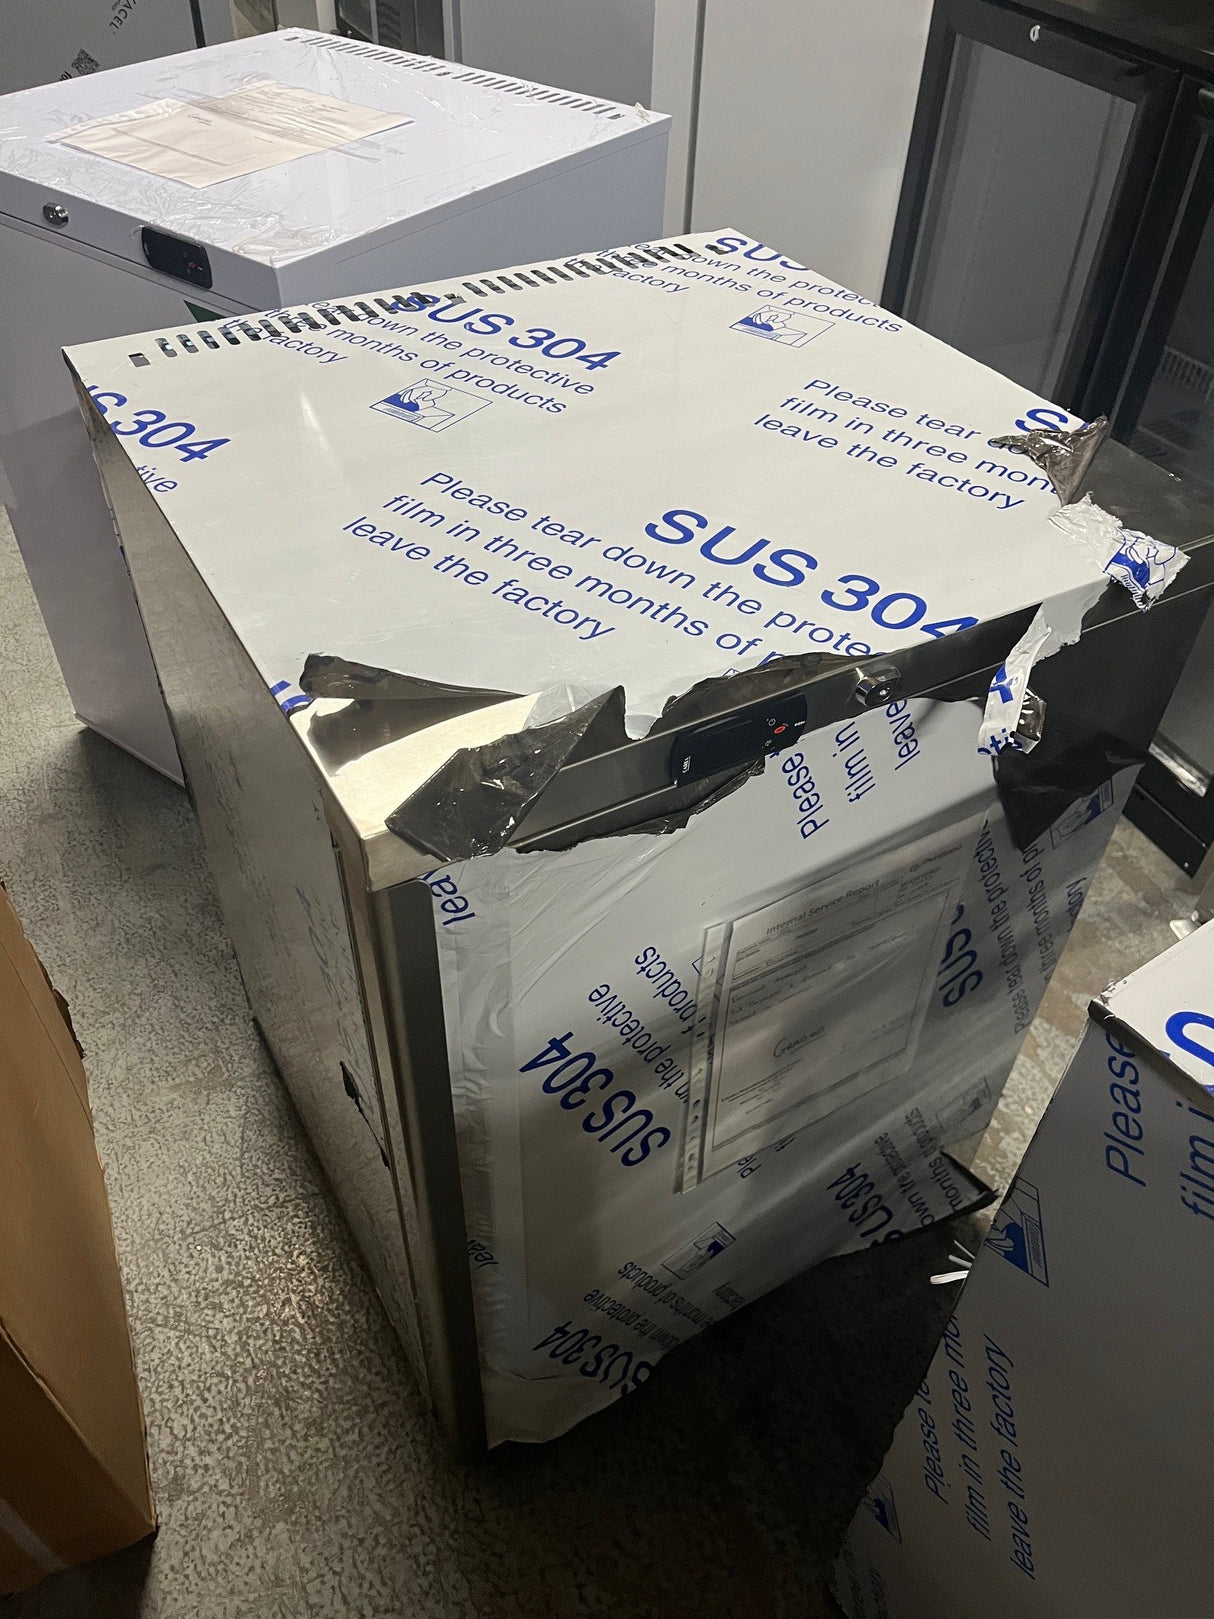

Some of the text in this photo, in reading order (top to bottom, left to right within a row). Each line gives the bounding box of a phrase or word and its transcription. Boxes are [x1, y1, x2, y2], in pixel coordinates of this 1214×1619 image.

[606, 268, 690, 294] actory
[660, 264, 752, 293] months
[756, 288, 787, 300] of
[783, 297, 904, 334] products
[746, 266, 787, 284] the
[391, 294, 621, 371] SUS 304
[420, 330, 463, 351] the
[459, 346, 595, 395] protective
[326, 328, 419, 363] months
[419, 357, 457, 372] of
[447, 367, 568, 414] products
[110, 410, 232, 463] 304
[779, 396, 839, 423] film
[844, 415, 875, 435] in
[881, 428, 970, 465] three
[802, 379, 982, 441] Please tear
[753, 413, 1026, 511] leave the factory
[342, 515, 617, 641] leave the factory
[382, 494, 763, 657] film in three months of
[419, 471, 529, 522] Please
[530, 514, 603, 550] tear
[602, 544, 698, 590] down
[701, 580, 763, 615] the
[644, 508, 980, 641] SUS 304
[833, 721, 876, 803] film in
[886, 700, 921, 771] leave
[781, 752, 830, 840] Please
[1019, 861, 1043, 884] of
[1026, 879, 1051, 936] months
[766, 910, 807, 936] Internal
[988, 900, 1008, 931] the
[998, 930, 1019, 968] down
[634, 946, 698, 1023] products
[587, 983, 685, 1090] the protective
[518, 1030, 671, 1167] SUS 304
[1103, 1032, 1148, 1188] Please
[826, 1162, 876, 1211] 304
[583, 1288, 640, 1329] protective
[617, 1261, 671, 1304] products
[531, 1320, 603, 1366] 304
[947, 1369, 979, 1453] three
[917, 1406, 950, 1506] Please
[958, 1453, 984, 1487] in
[983, 1331, 1037, 1581] leave the factory
[965, 1485, 993, 1542] film
